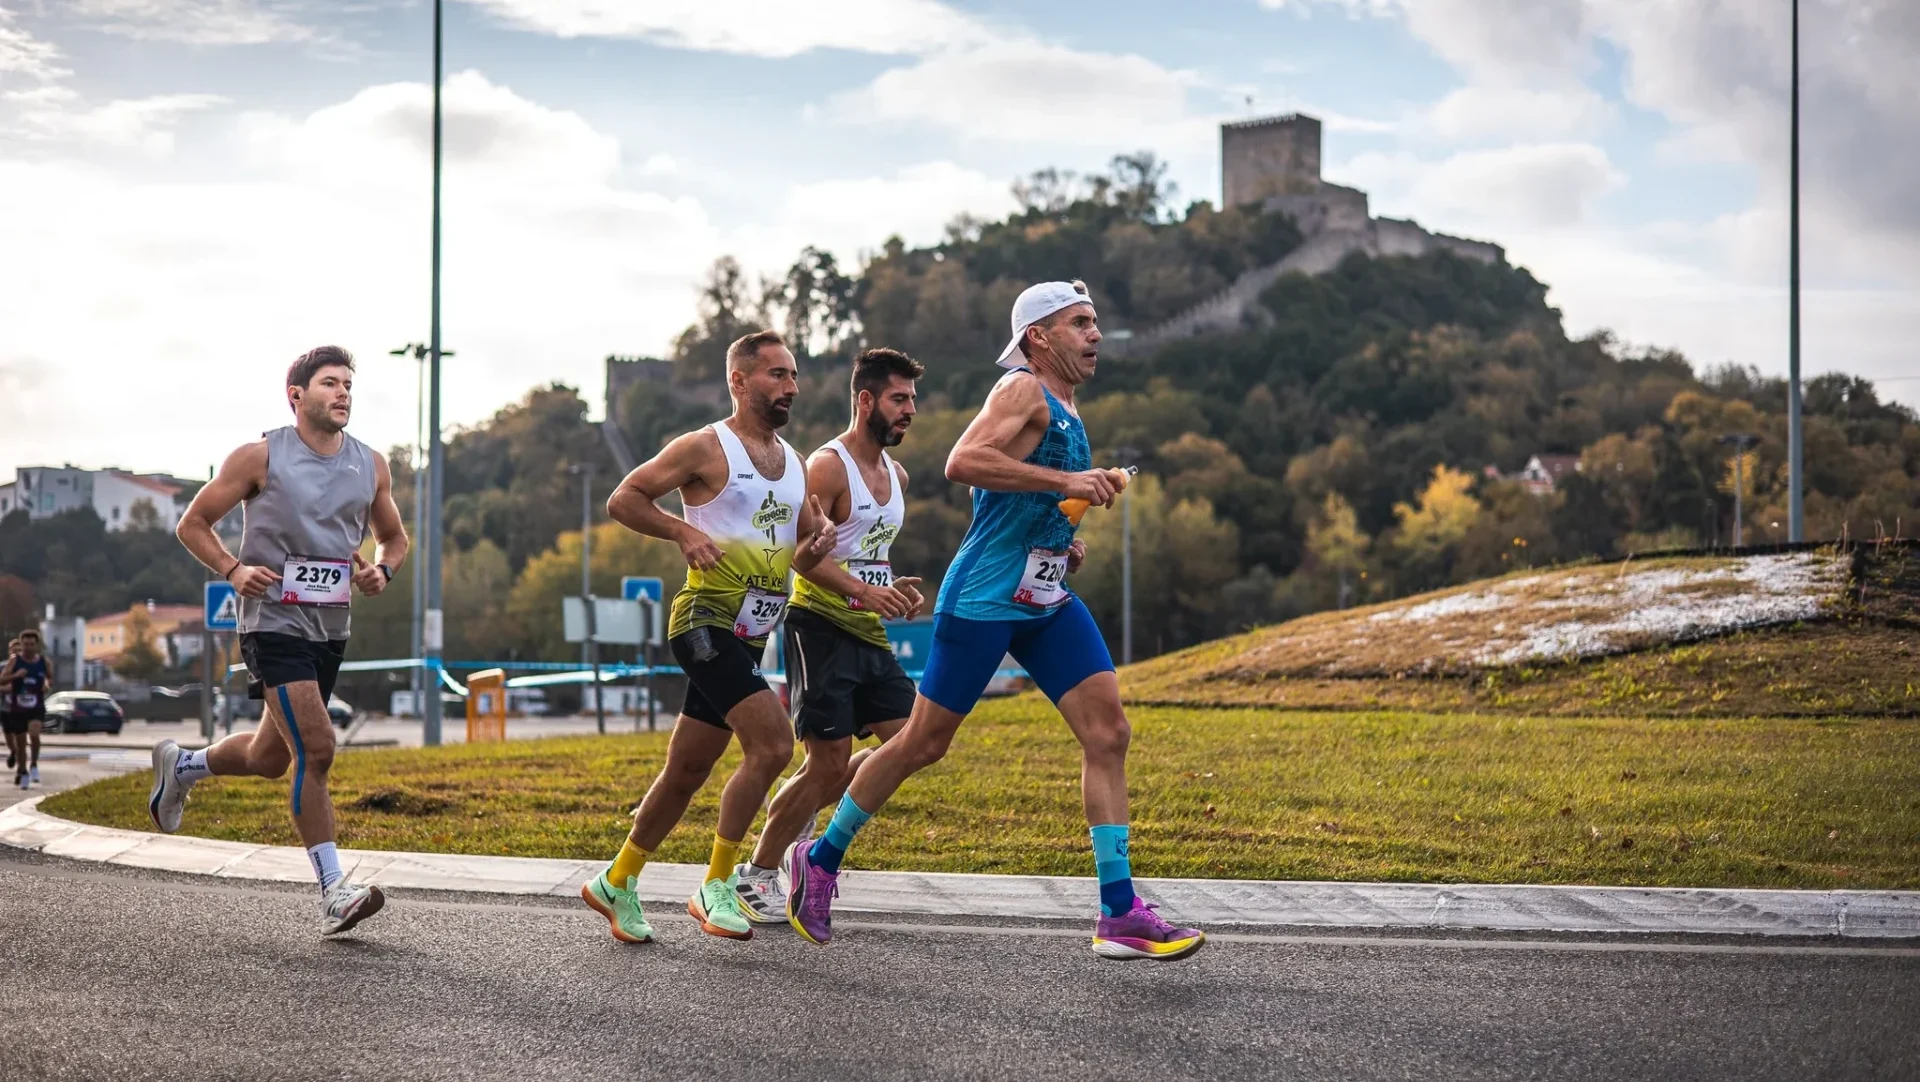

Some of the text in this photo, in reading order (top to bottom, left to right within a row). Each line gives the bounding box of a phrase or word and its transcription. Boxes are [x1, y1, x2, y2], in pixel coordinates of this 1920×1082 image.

[758, 508, 788, 524] PENICHE
[295, 565, 341, 585] 2379
[859, 570, 888, 586] 3292
[284, 591, 299, 601] 21k
[1019, 588, 1034, 601] 21k
[752, 600, 783, 618] 3296
